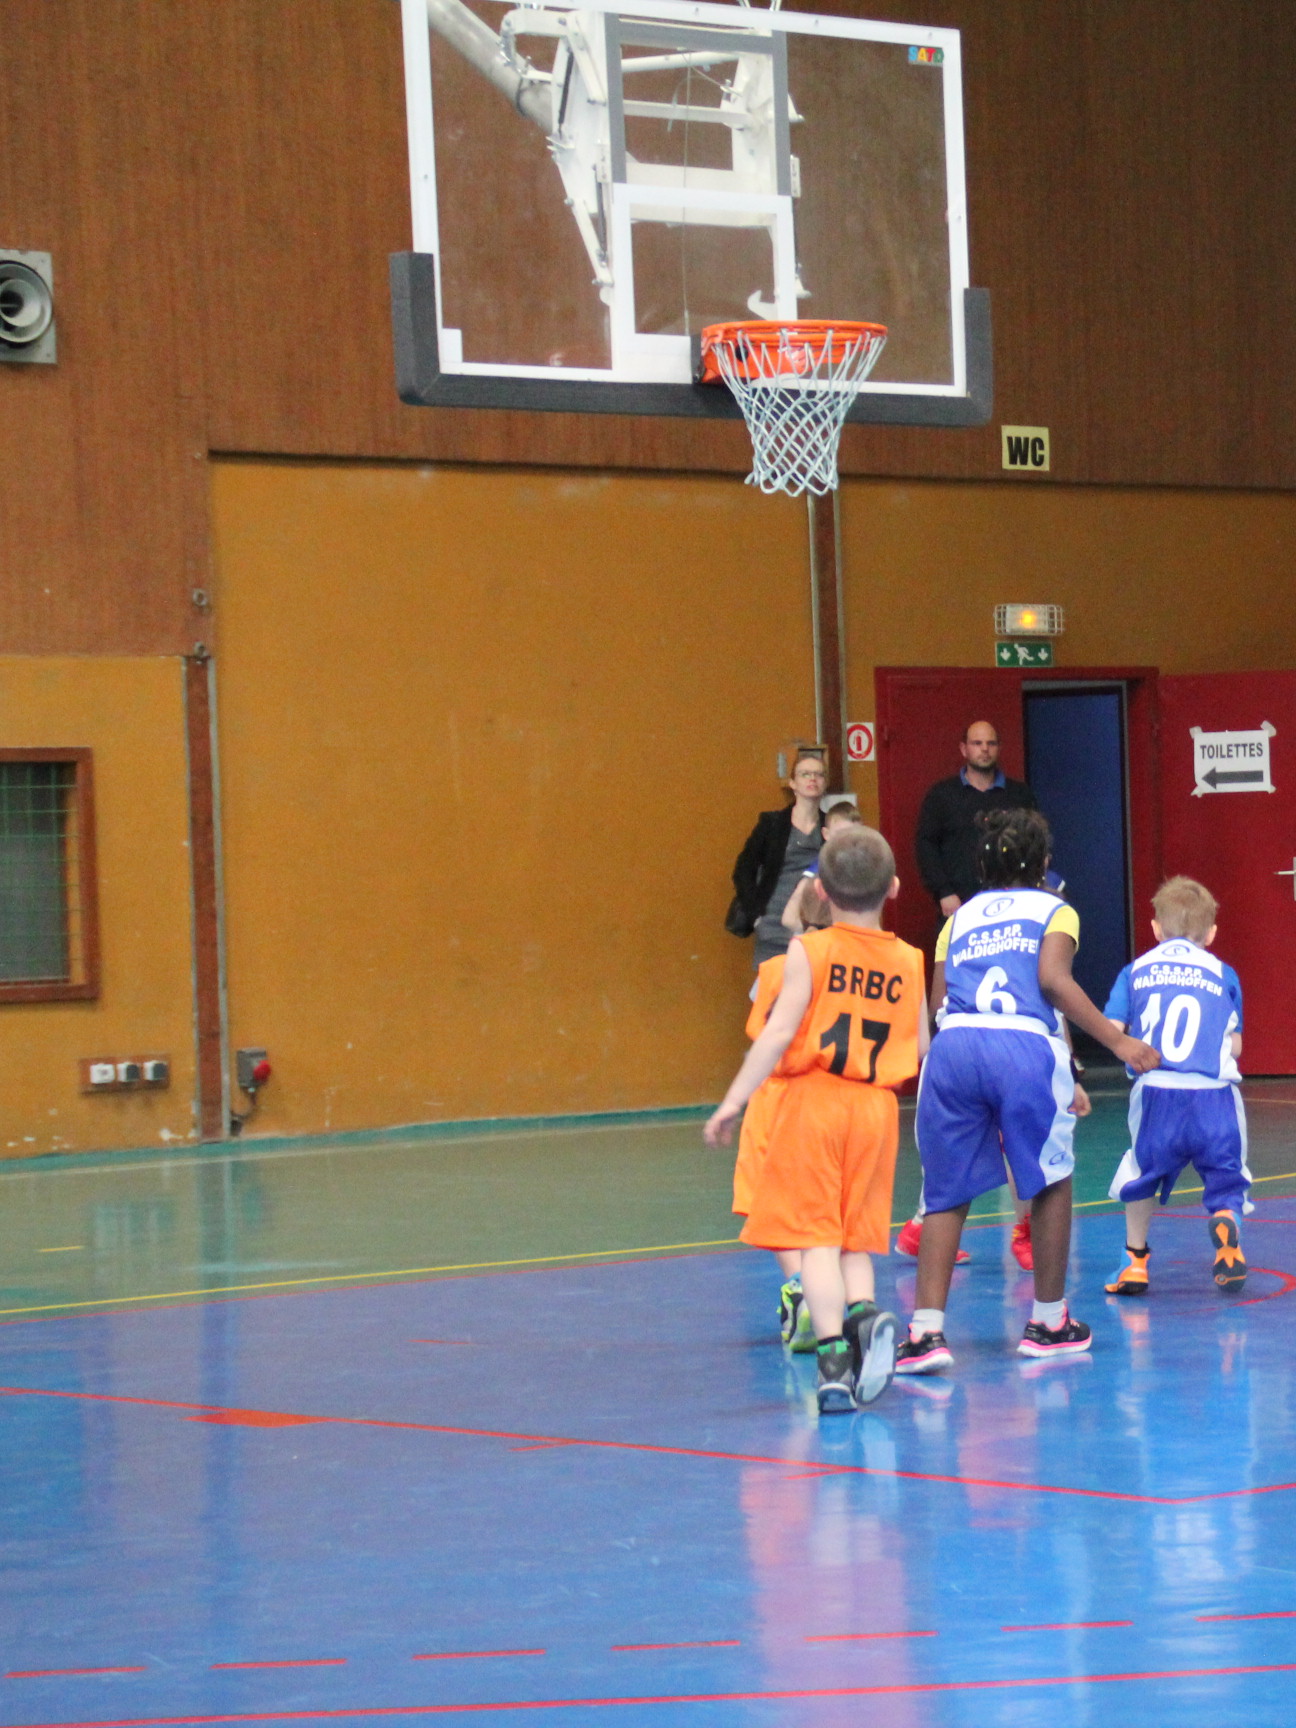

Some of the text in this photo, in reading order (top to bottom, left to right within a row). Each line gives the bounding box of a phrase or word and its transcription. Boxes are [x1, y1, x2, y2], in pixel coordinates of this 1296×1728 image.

[1006, 436, 1044, 467] WC
[1200, 743, 1263, 759] TOILETTES
[828, 964, 903, 1004] BRBC
[976, 966, 1016, 1014] 6
[820, 1012, 891, 1084] 17
[1140, 993, 1202, 1063] 10
